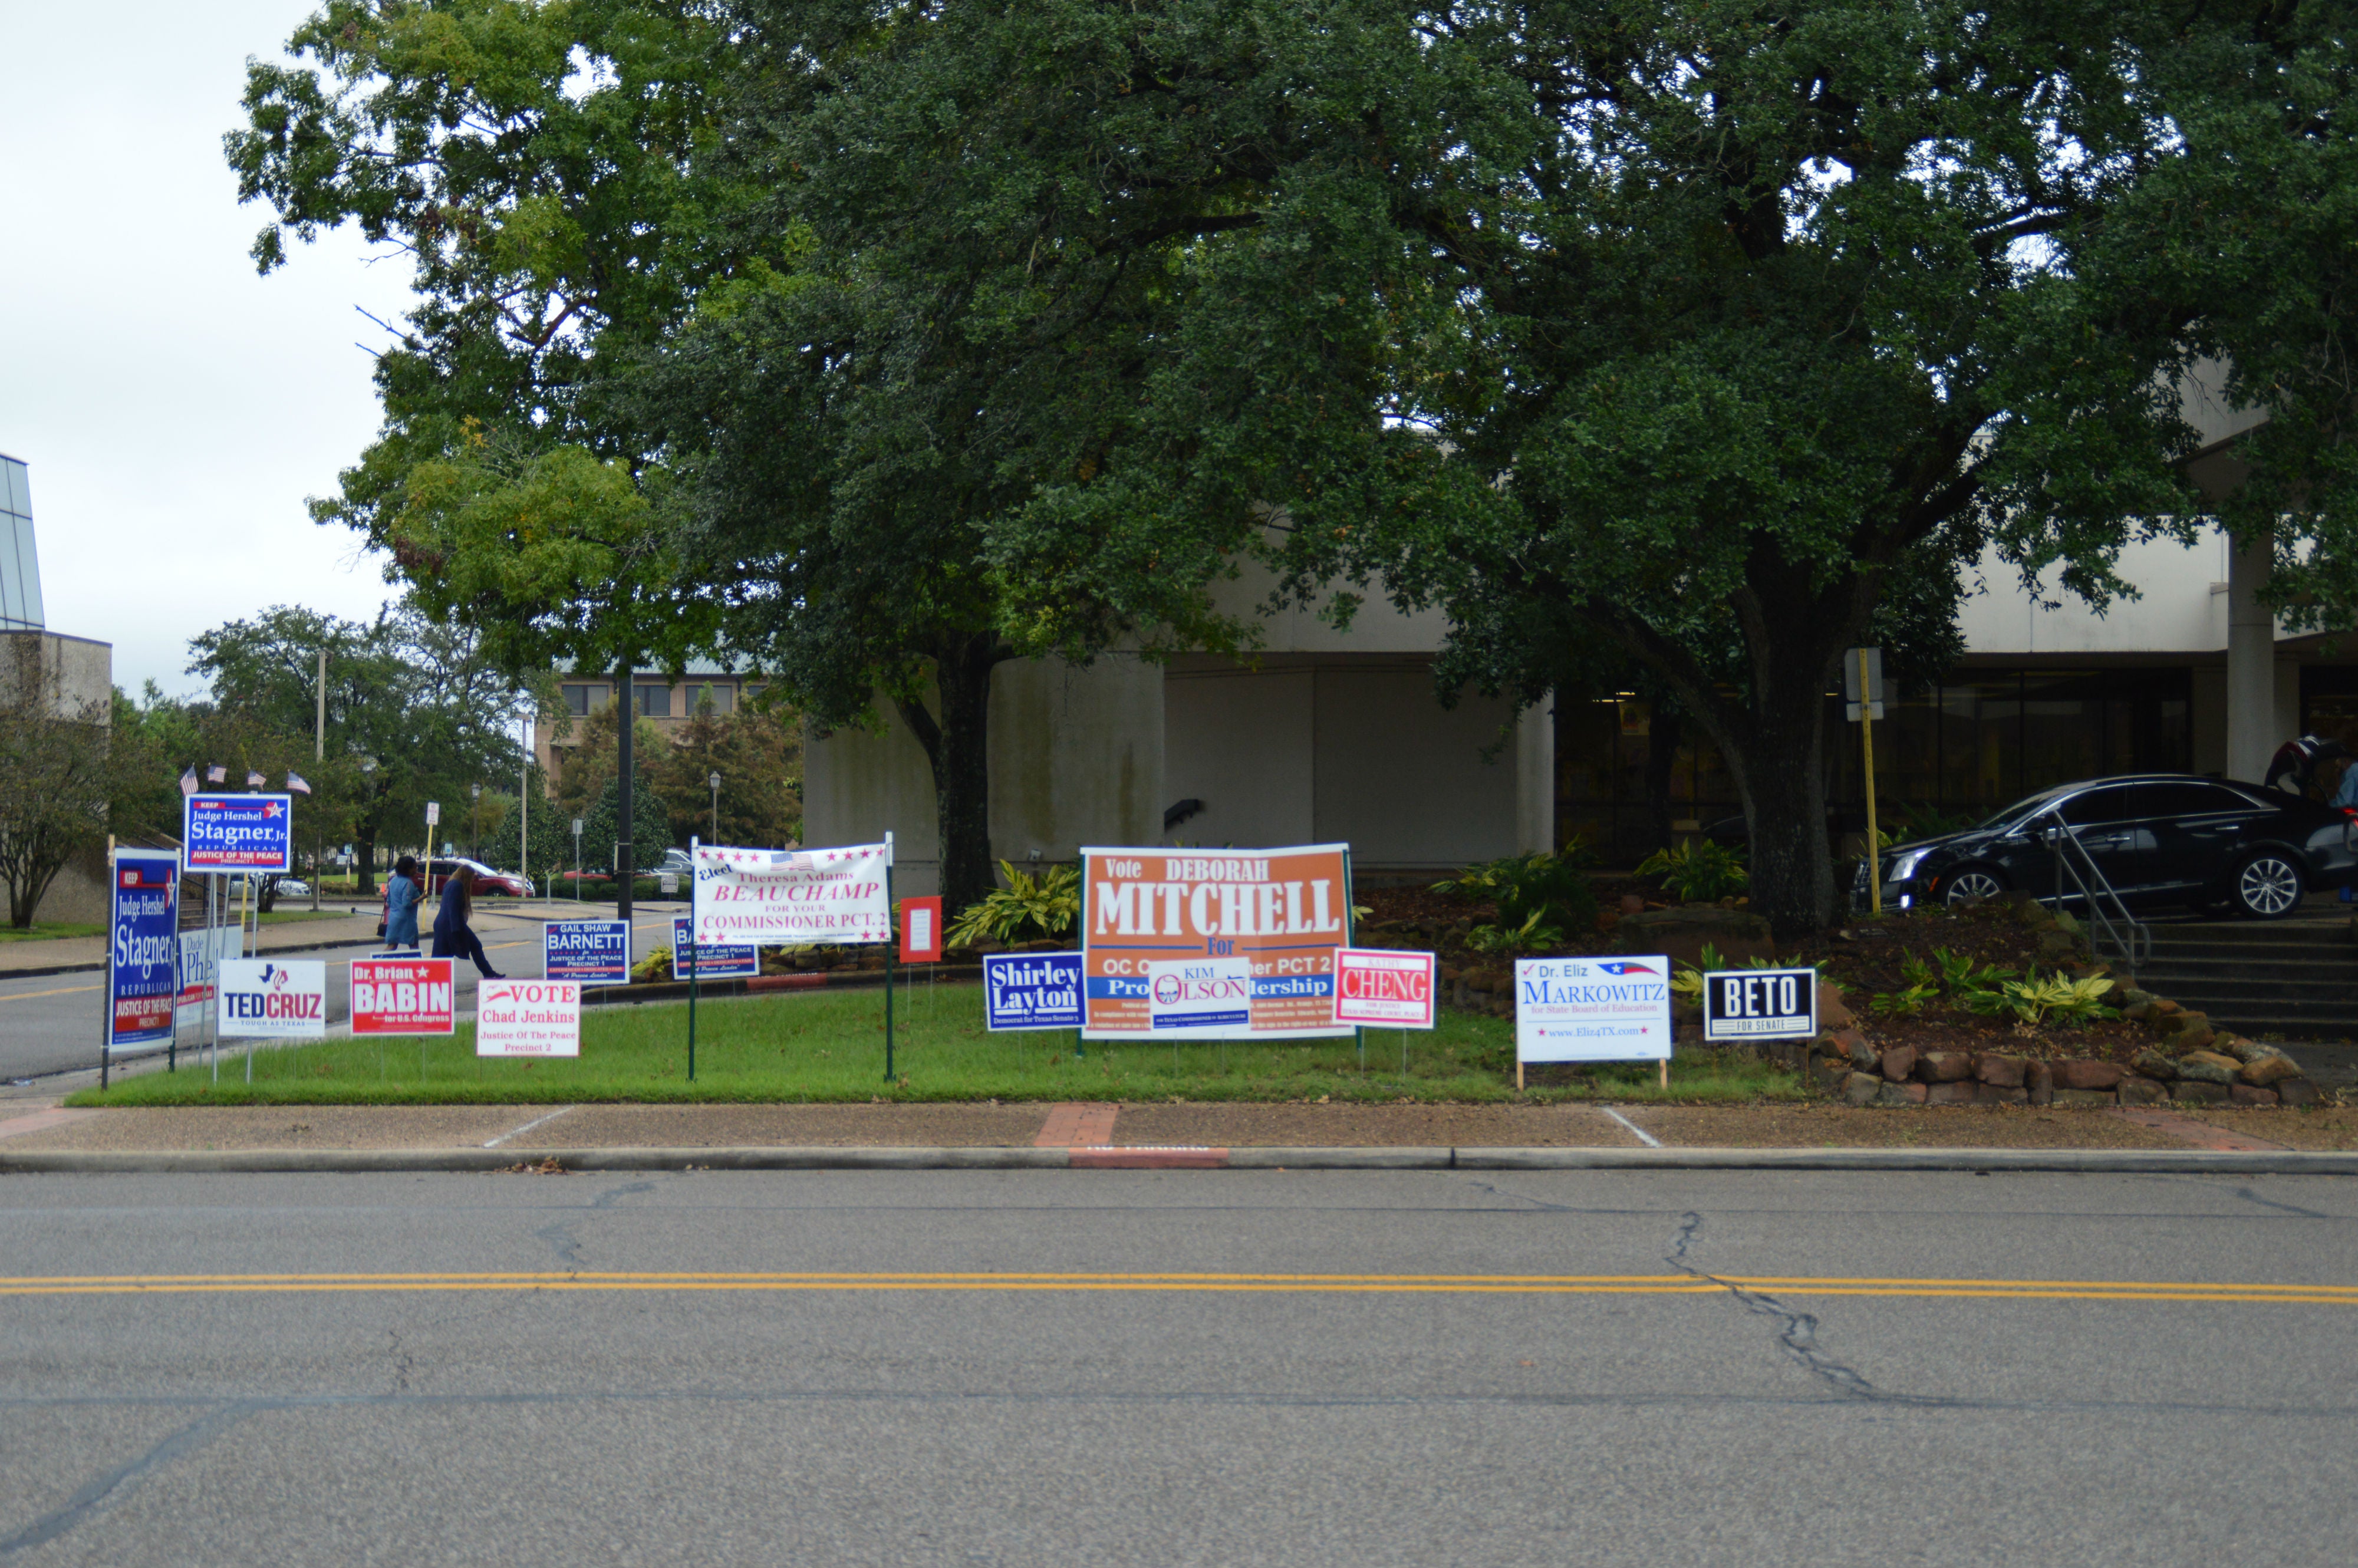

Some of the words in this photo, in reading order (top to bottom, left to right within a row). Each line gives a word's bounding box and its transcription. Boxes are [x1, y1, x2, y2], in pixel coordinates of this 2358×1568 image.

[193, 811, 222, 822] Judge
[224, 811, 262, 821] Hershel
[192, 822, 274, 845] Stagner,
[275, 830, 288, 842] Jr.
[124, 872, 138, 884] KEEP
[699, 864, 734, 881] Elect
[737, 872, 798, 883] Theresa
[803, 872, 854, 882] Adams
[1105, 859, 1141, 878] Vote
[1166, 859, 1269, 881] DEBORAH
[713, 882, 879, 902] BEAUCHAMP
[118, 895, 140, 922] Judge
[141, 895, 165, 915] Hershel
[1096, 879, 1340, 935] MITCHELL
[560, 924, 582, 933] GAIL
[703, 915, 835, 929] COMMISSIONER
[841, 913, 875, 927] PCT.
[880, 913, 885, 925] 2
[186, 935, 203, 951] Dade
[548, 934, 624, 949] BARNETT
[1207, 937, 1235, 956] For
[117, 924, 170, 980] Stagner,
[1103, 958, 1132, 975] OC
[1278, 957, 1315, 974] PCT
[1320, 956, 1331, 971] 2
[1368, 958, 1401, 968] KATHY
[1539, 966, 1559, 977] Dr.
[1565, 964, 1588, 977] Eliz
[354, 967, 372, 980] Dr.
[375, 967, 414, 980] Brian
[992, 961, 1081, 991] Shirley
[1185, 967, 1214, 979] KIM
[121, 981, 171, 996] REPUBLICAN
[1154, 974, 1246, 1004] OLSON
[1342, 969, 1427, 1001] CHENG
[1523, 981, 1665, 1004] MARKOWITZ
[177, 994, 195, 1004] EPUBLICAN
[202, 990, 213, 998] TXAS
[354, 983, 449, 1013] BABIN
[509, 985, 575, 1003] VOTE
[993, 987, 1078, 1015] Layton
[1725, 976, 1796, 1017] BETO
[116, 1000, 142, 1017] JUSTICE
[143, 999, 151, 1014] OF
[160, 997, 172, 1013] PEACE
[1532, 1006, 1543, 1014] for
[1547, 1004, 1568, 1014] State
[1572, 1004, 1599, 1013] Board
[1601, 1004, 1611, 1013] of
[1612, 1003, 1658, 1013] Education
[139, 1017, 157, 1027] PRECINCT
[413, 1014, 449, 1023] Congress
[482, 1009, 516, 1023] Chad
[521, 1010, 575, 1023] Jenkins
[1549, 1026, 1639, 1037] www.Eliz4TX.com
[1737, 1022, 1752, 1031] FOR
[1757, 1020, 1785, 1030] SENATE
[481, 1031, 513, 1039] Justice
[505, 1043, 542, 1052] Precinct
[546, 1043, 552, 1052] 2
